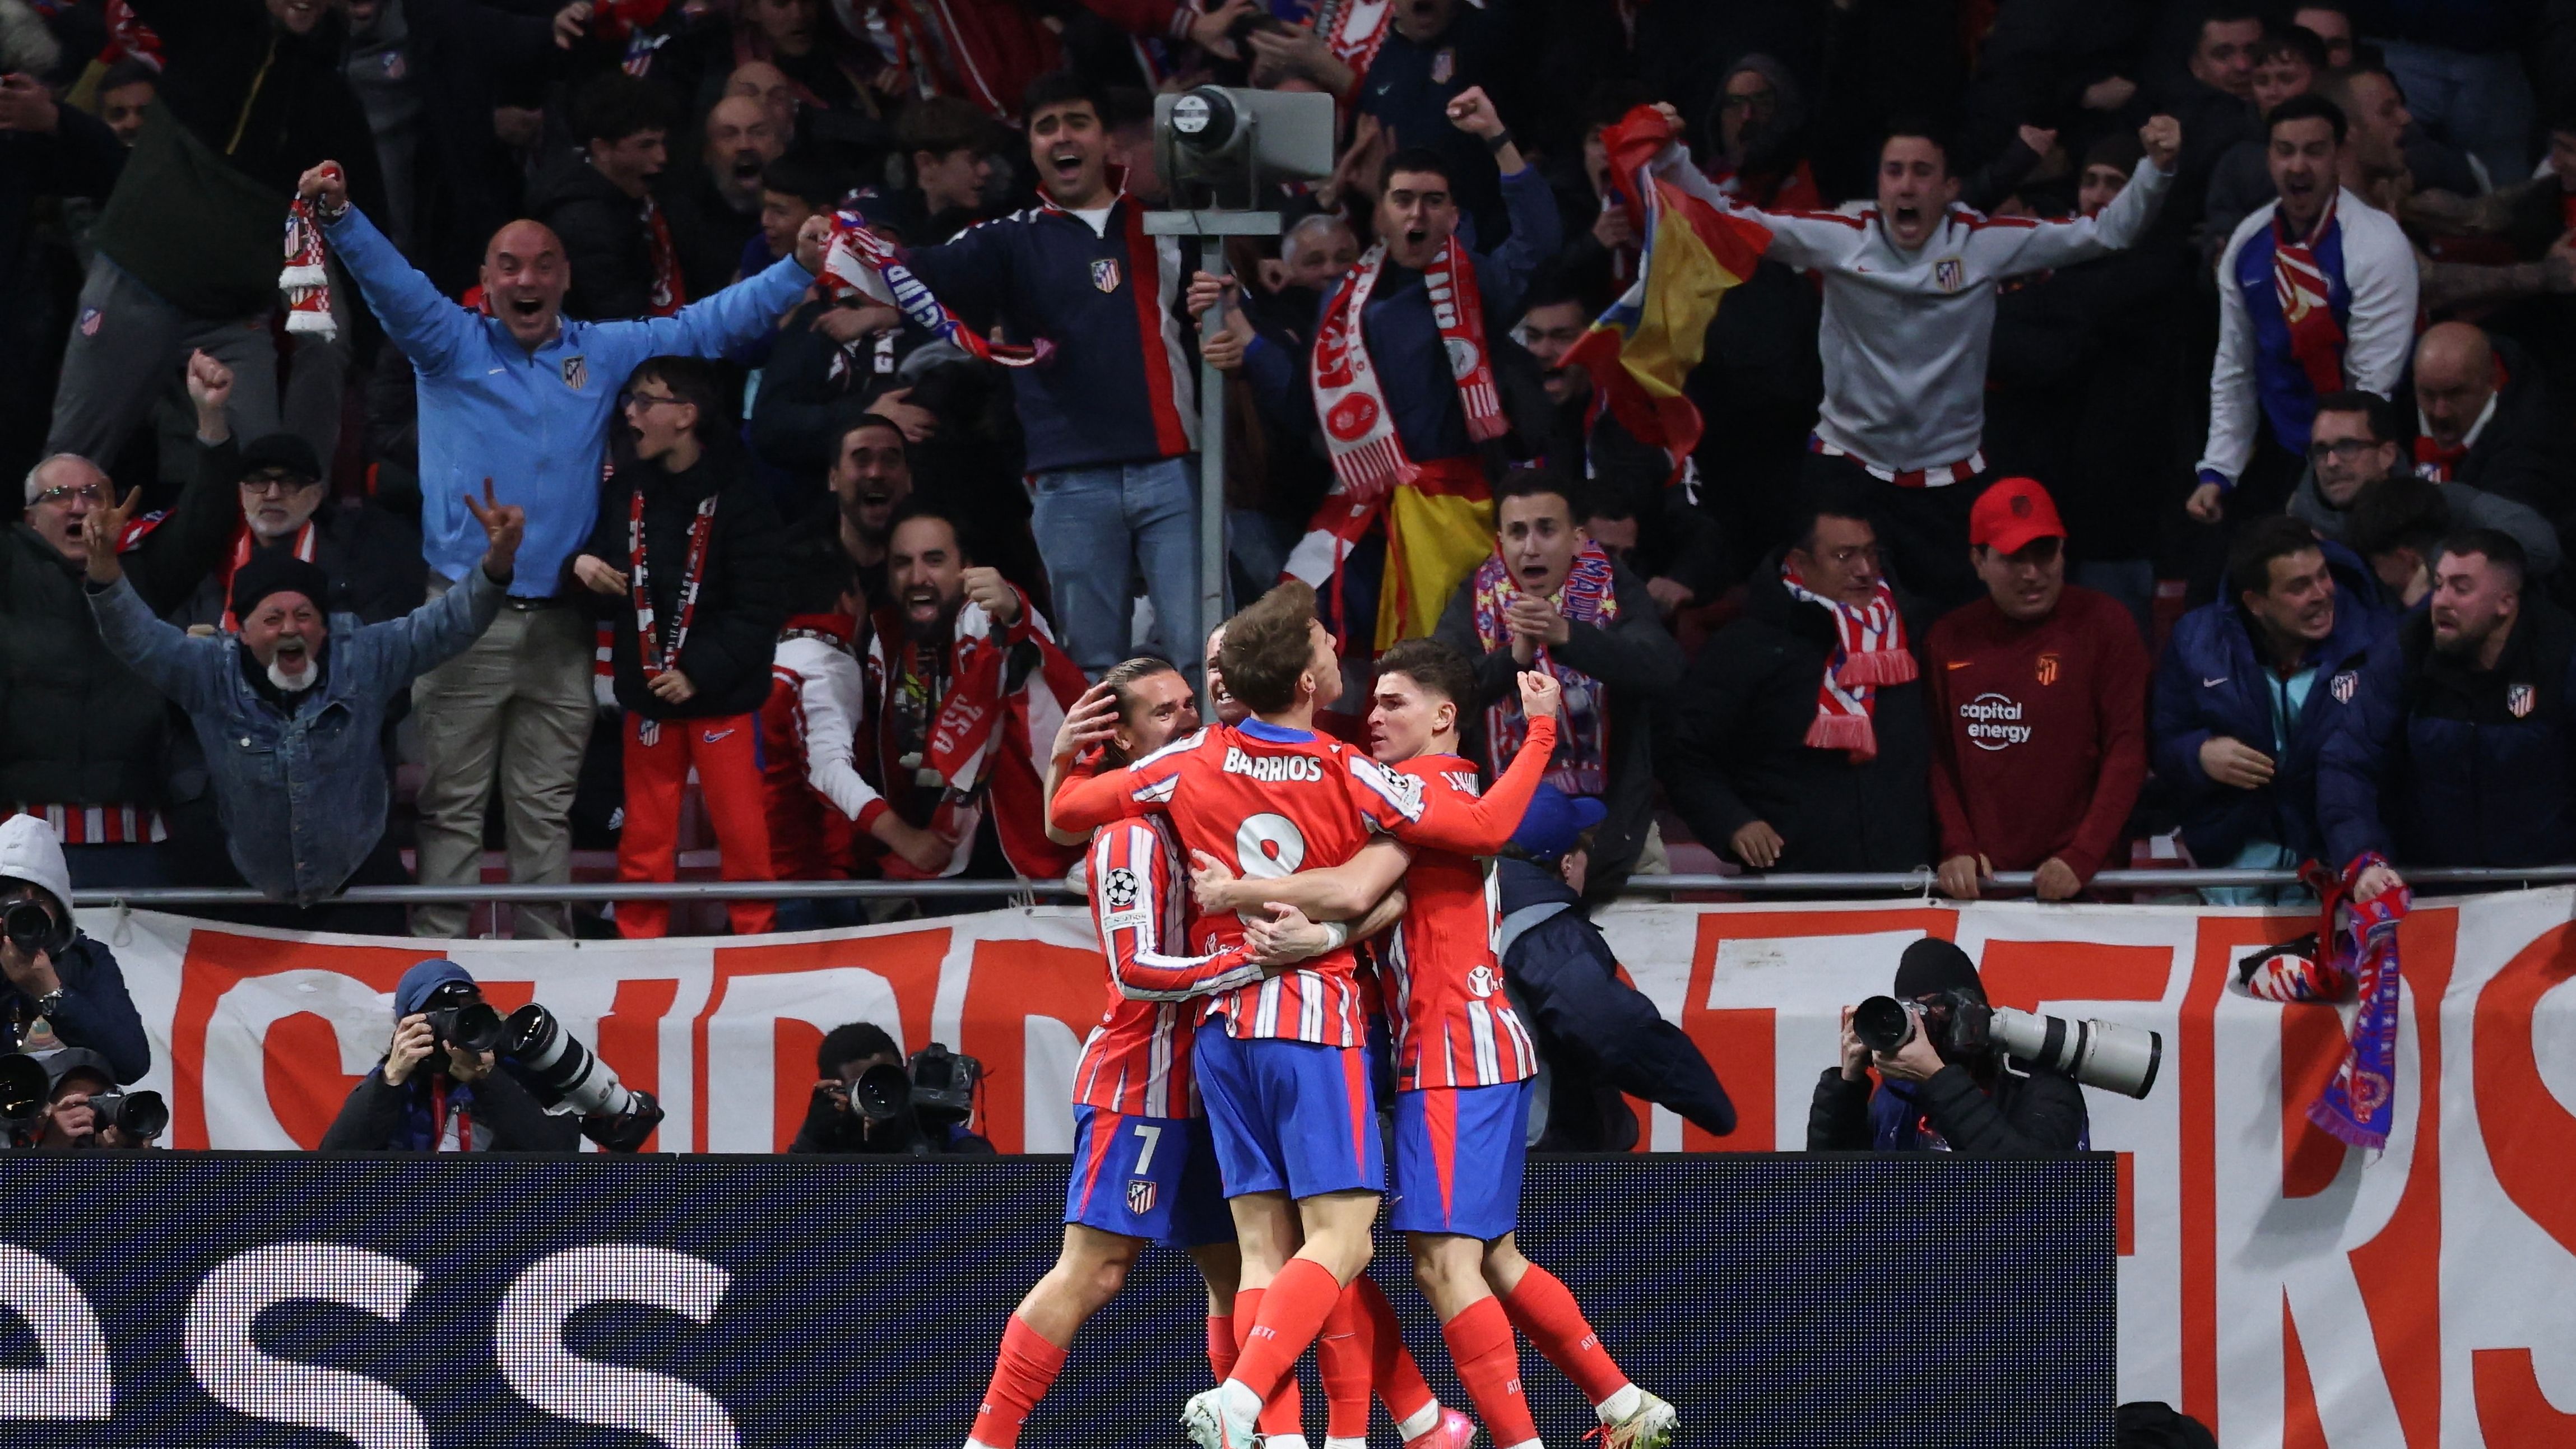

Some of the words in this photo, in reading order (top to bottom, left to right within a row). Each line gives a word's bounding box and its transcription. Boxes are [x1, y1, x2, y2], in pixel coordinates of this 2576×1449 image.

[1960, 701, 2022, 722] capital
[1967, 723, 2031, 743] energy
[1223, 746, 1322, 782] BARRIOS
[1134, 1124, 1162, 1176] 7
